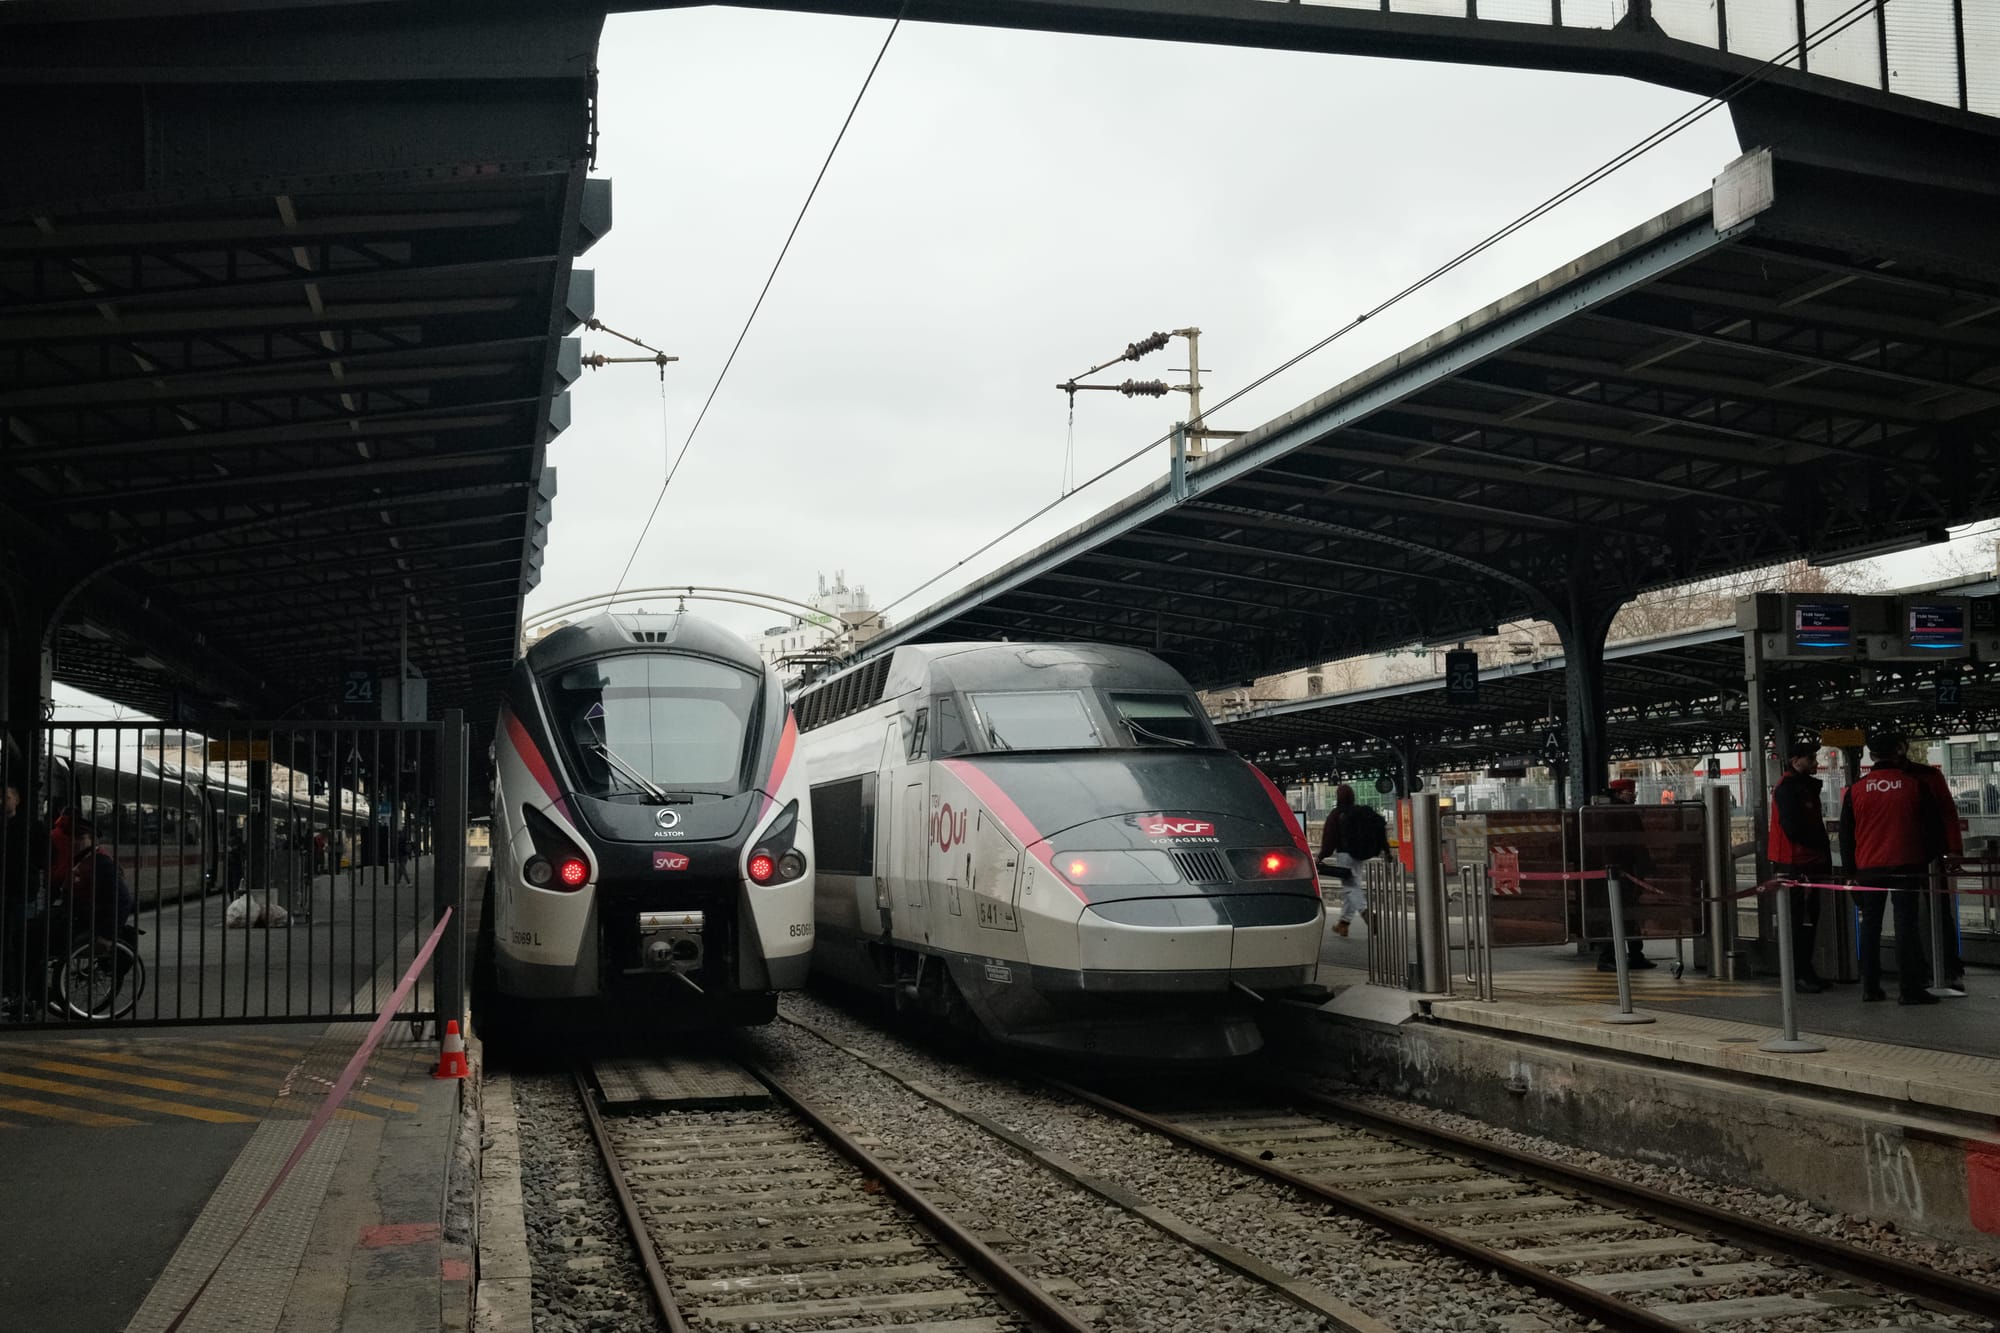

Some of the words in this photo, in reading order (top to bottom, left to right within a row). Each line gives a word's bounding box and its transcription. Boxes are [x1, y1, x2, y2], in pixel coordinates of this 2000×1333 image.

[1451, 672, 1474, 690] 26
[345, 680, 373, 699] 24
[1939, 686, 1957, 702] 27
[1545, 732, 1559, 748] A
[1331, 768, 1340, 778] A
[1149, 823, 1210, 834] SNCF
[1150, 836, 1220, 844] VOYAGEURS
[655, 858, 687, 869] SNCF
[980, 903, 998, 924] 541
[534, 932, 542, 946] L
